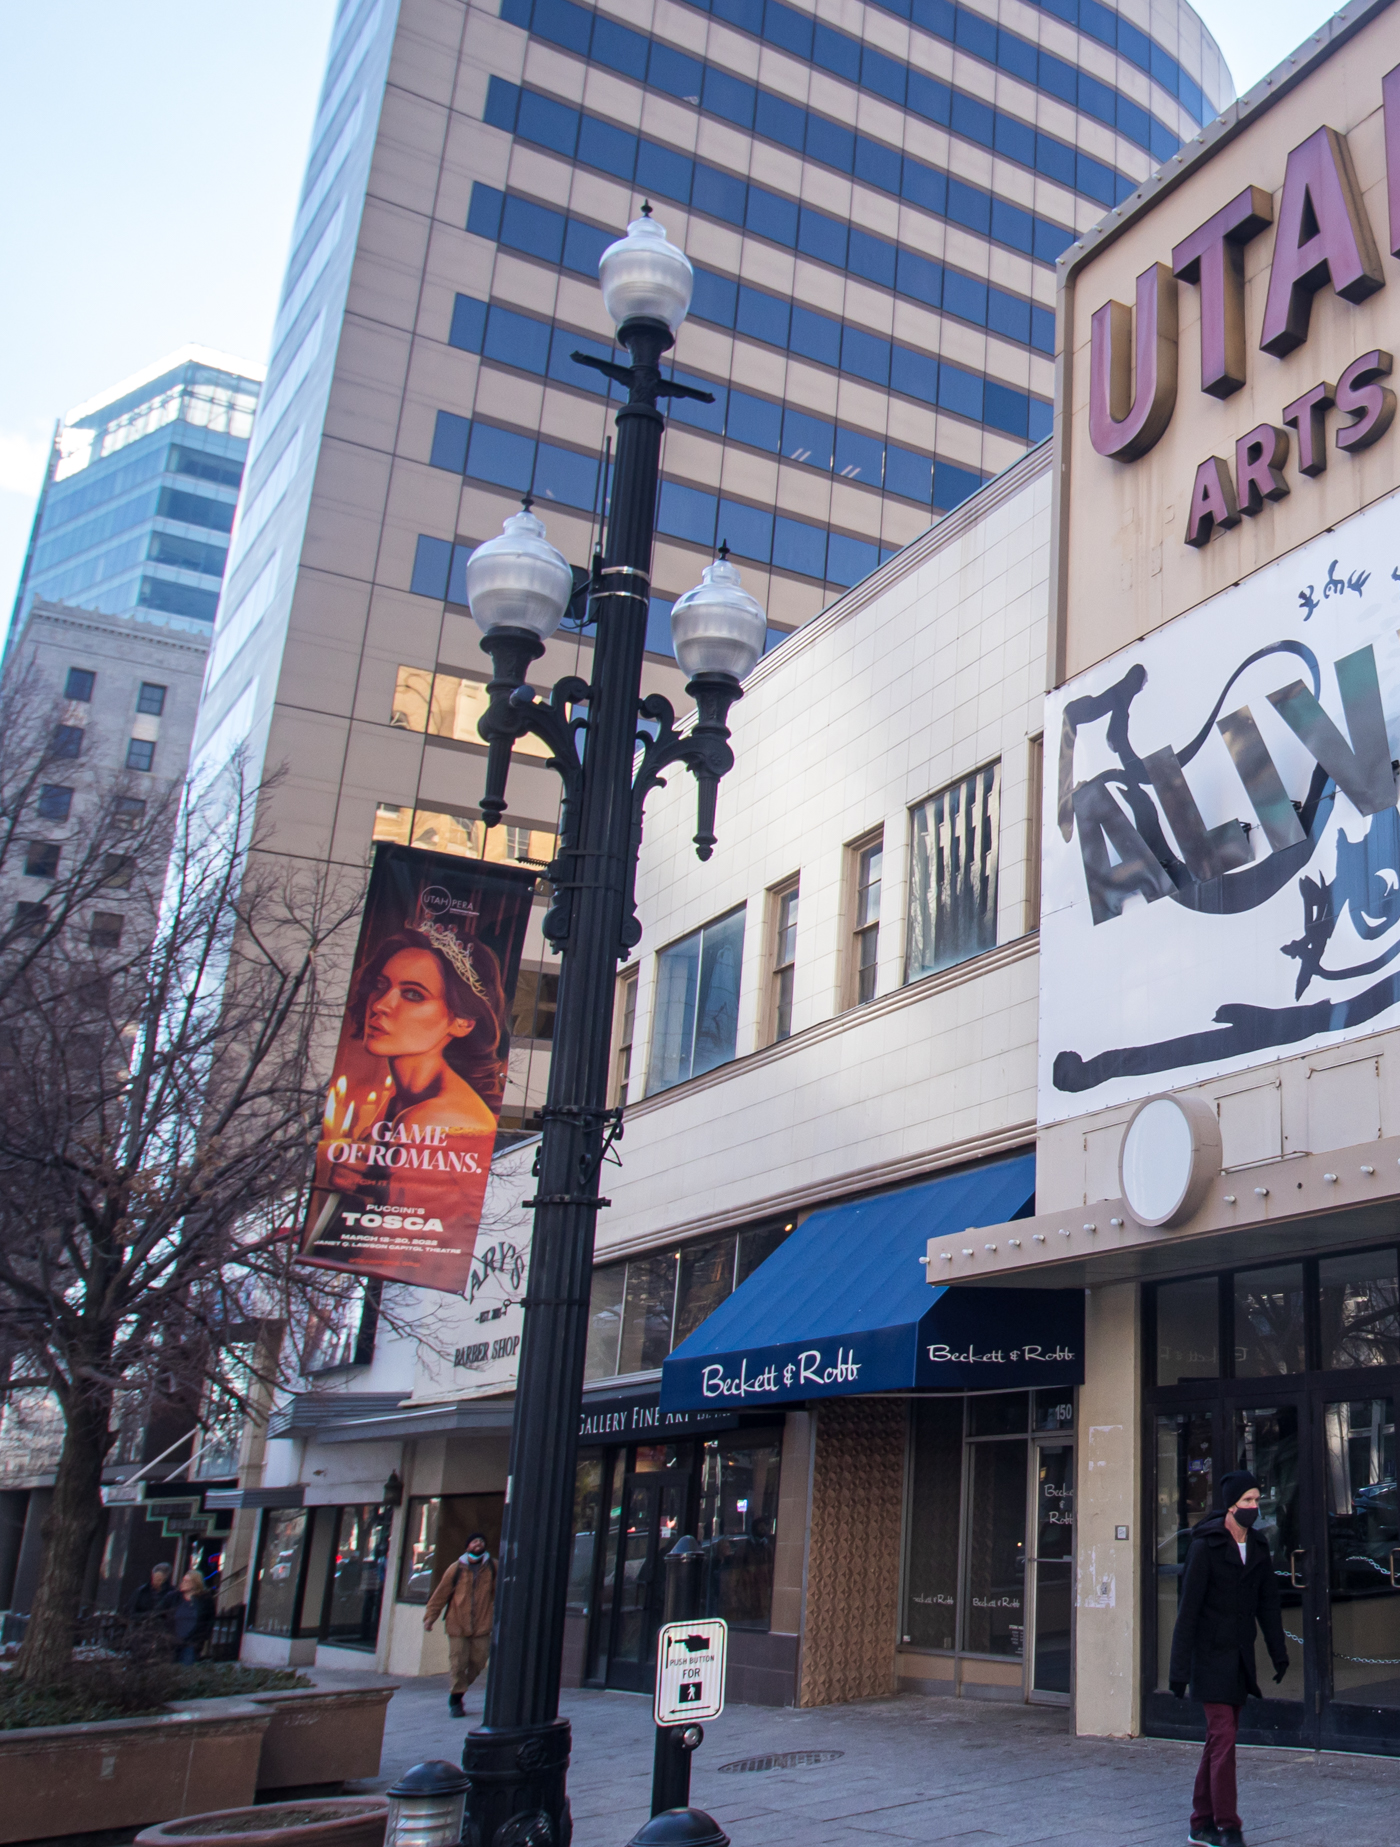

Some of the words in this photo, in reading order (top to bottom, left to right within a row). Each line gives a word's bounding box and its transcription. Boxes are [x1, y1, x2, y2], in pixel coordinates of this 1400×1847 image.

[1184, 349, 1398, 549] ARTS
[423, 895, 448, 906] UTAH
[371, 1121, 449, 1147] GAME
[327, 1142, 366, 1164] OF
[366, 1145, 482, 1174] ROMANS.
[366, 1204, 425, 1214] PUCCINI'S
[342, 1212, 444, 1232] TOSCA
[340, 1234, 378, 1242] MARCH
[351, 1242, 388, 1250] LAWSON
[388, 1244, 424, 1252] CAPITOL
[425, 1246, 461, 1254] THEATRE
[454, 1341, 490, 1367] BARBER
[491, 1335, 521, 1360] SHOP
[926, 1344, 1007, 1364] Beckett
[1009, 1349, 1020, 1361] &
[1021, 1345, 1075, 1361] Robb
[701, 1358, 780, 1398] Beckett
[783, 1363, 795, 1386] &
[797, 1347, 862, 1386] Robb
[632, 1406, 661, 1429] FINE
[1055, 1403, 1073, 1420] 150
[1044, 1482, 1074, 1498] Becke
[670, 1657, 687, 1666] PUSH
[690, 1655, 714, 1665] BUTTON
[683, 1668, 700, 1679] FOR
